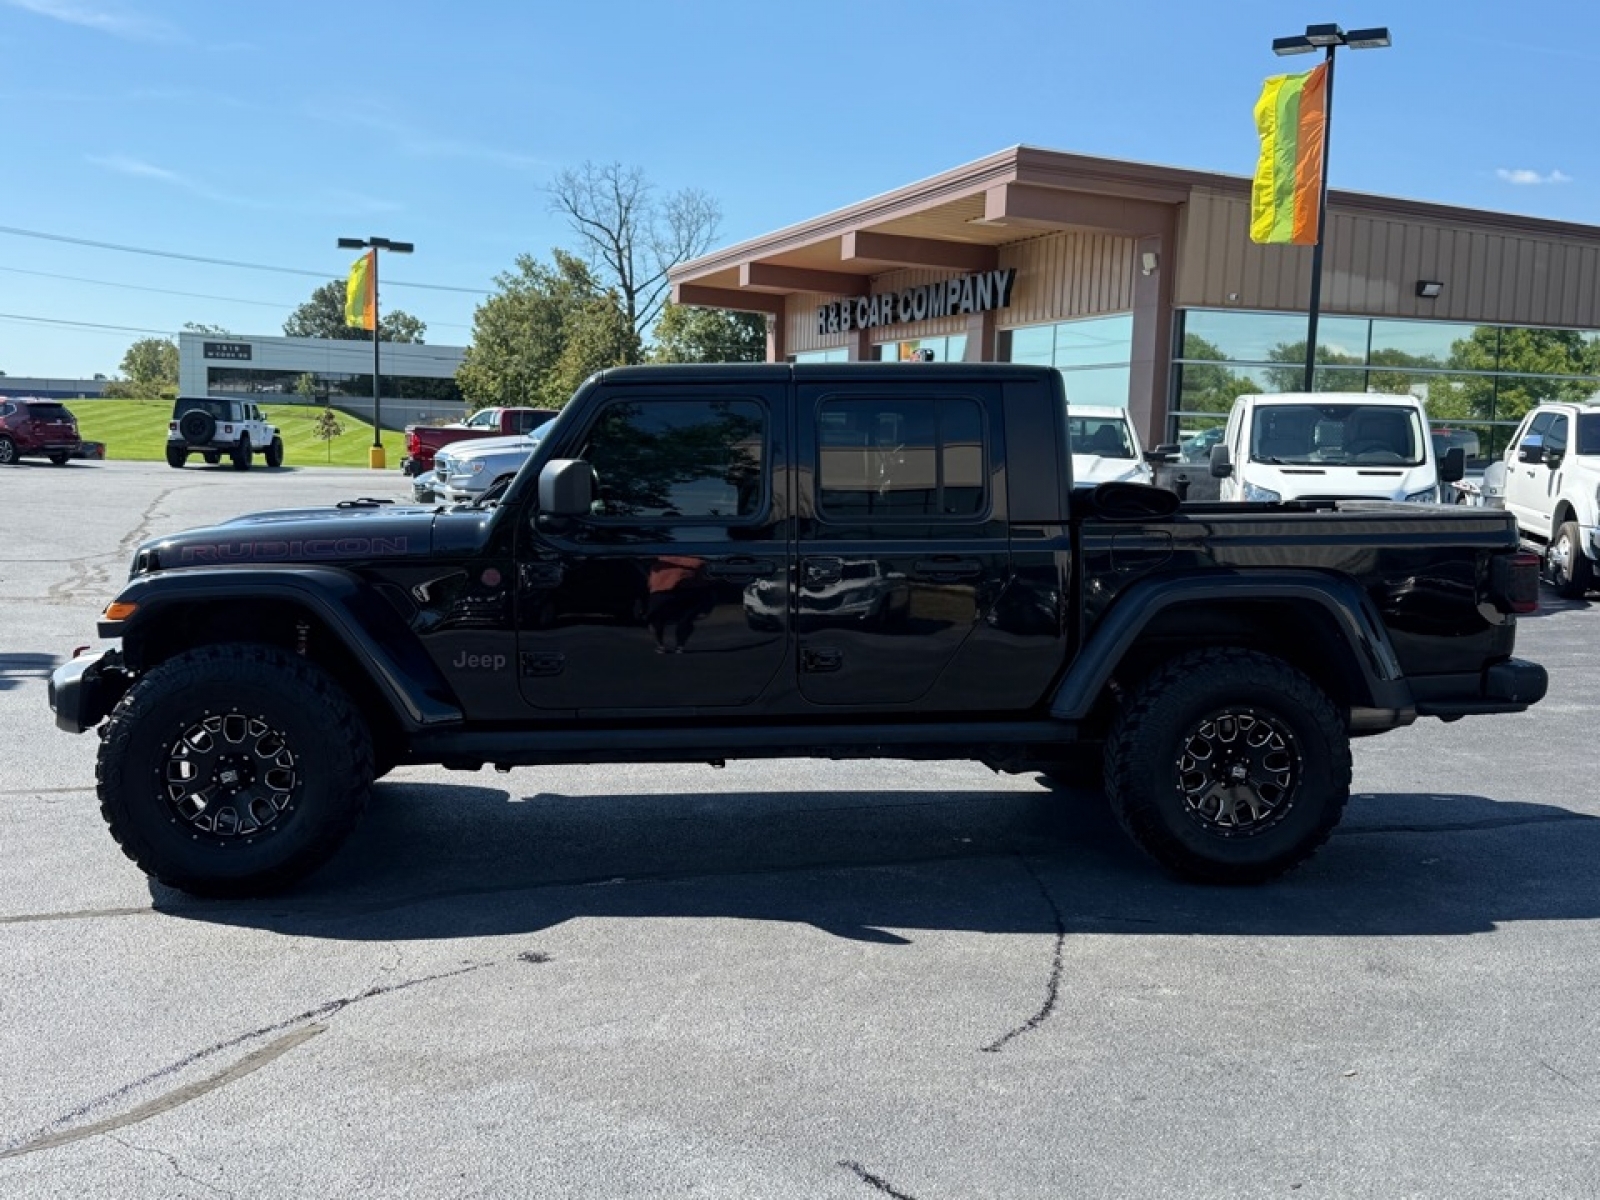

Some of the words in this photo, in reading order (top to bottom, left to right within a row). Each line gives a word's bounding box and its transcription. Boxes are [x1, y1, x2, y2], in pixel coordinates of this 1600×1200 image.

[817, 301, 851, 335] R&B
[857, 294, 895, 328] CAR
[900, 269, 1013, 322] COMPANY
[452, 649, 506, 671] Jeep
